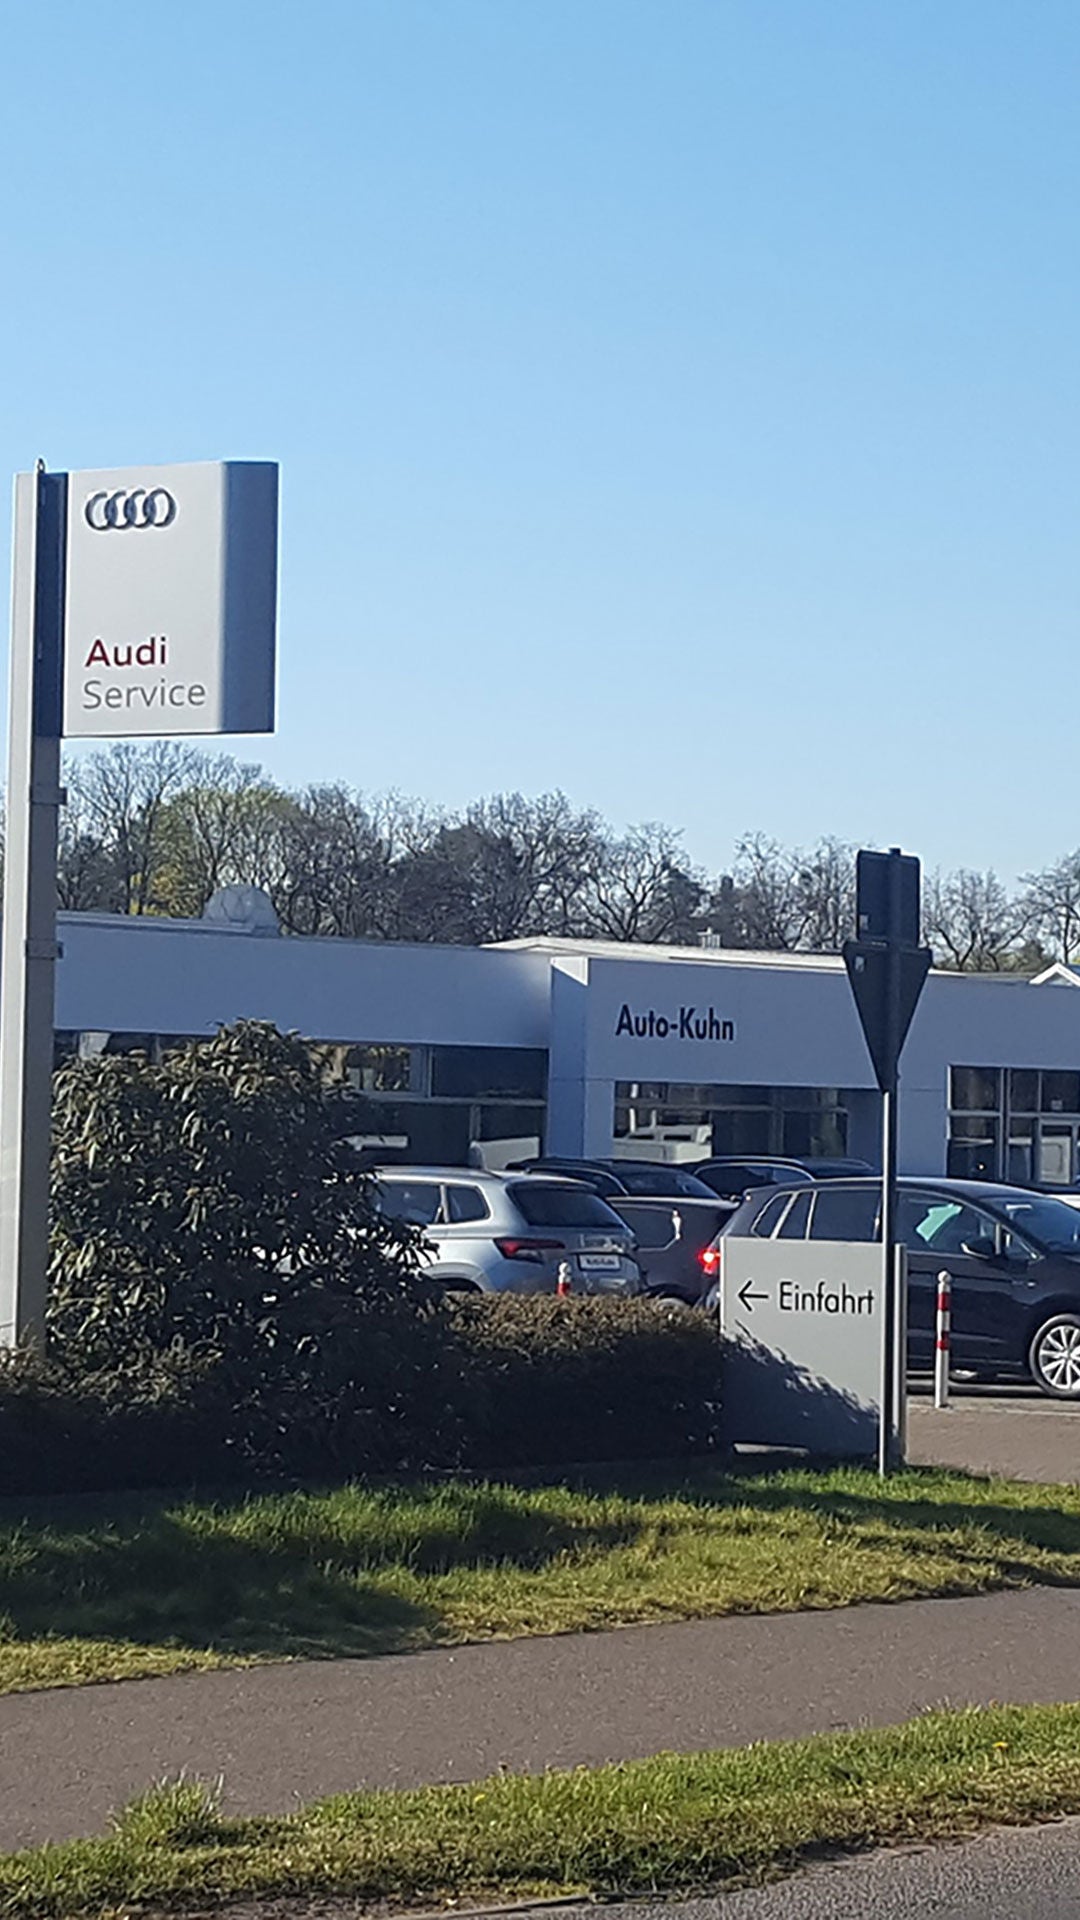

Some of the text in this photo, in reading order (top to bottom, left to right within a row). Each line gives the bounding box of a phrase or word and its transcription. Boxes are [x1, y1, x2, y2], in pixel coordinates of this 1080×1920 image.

[85, 636, 167, 668] Audi
[83, 678, 206, 710] Service
[615, 1003, 734, 1041] Auto-Kuhn
[779, 1281, 875, 1315] Einfahrt
